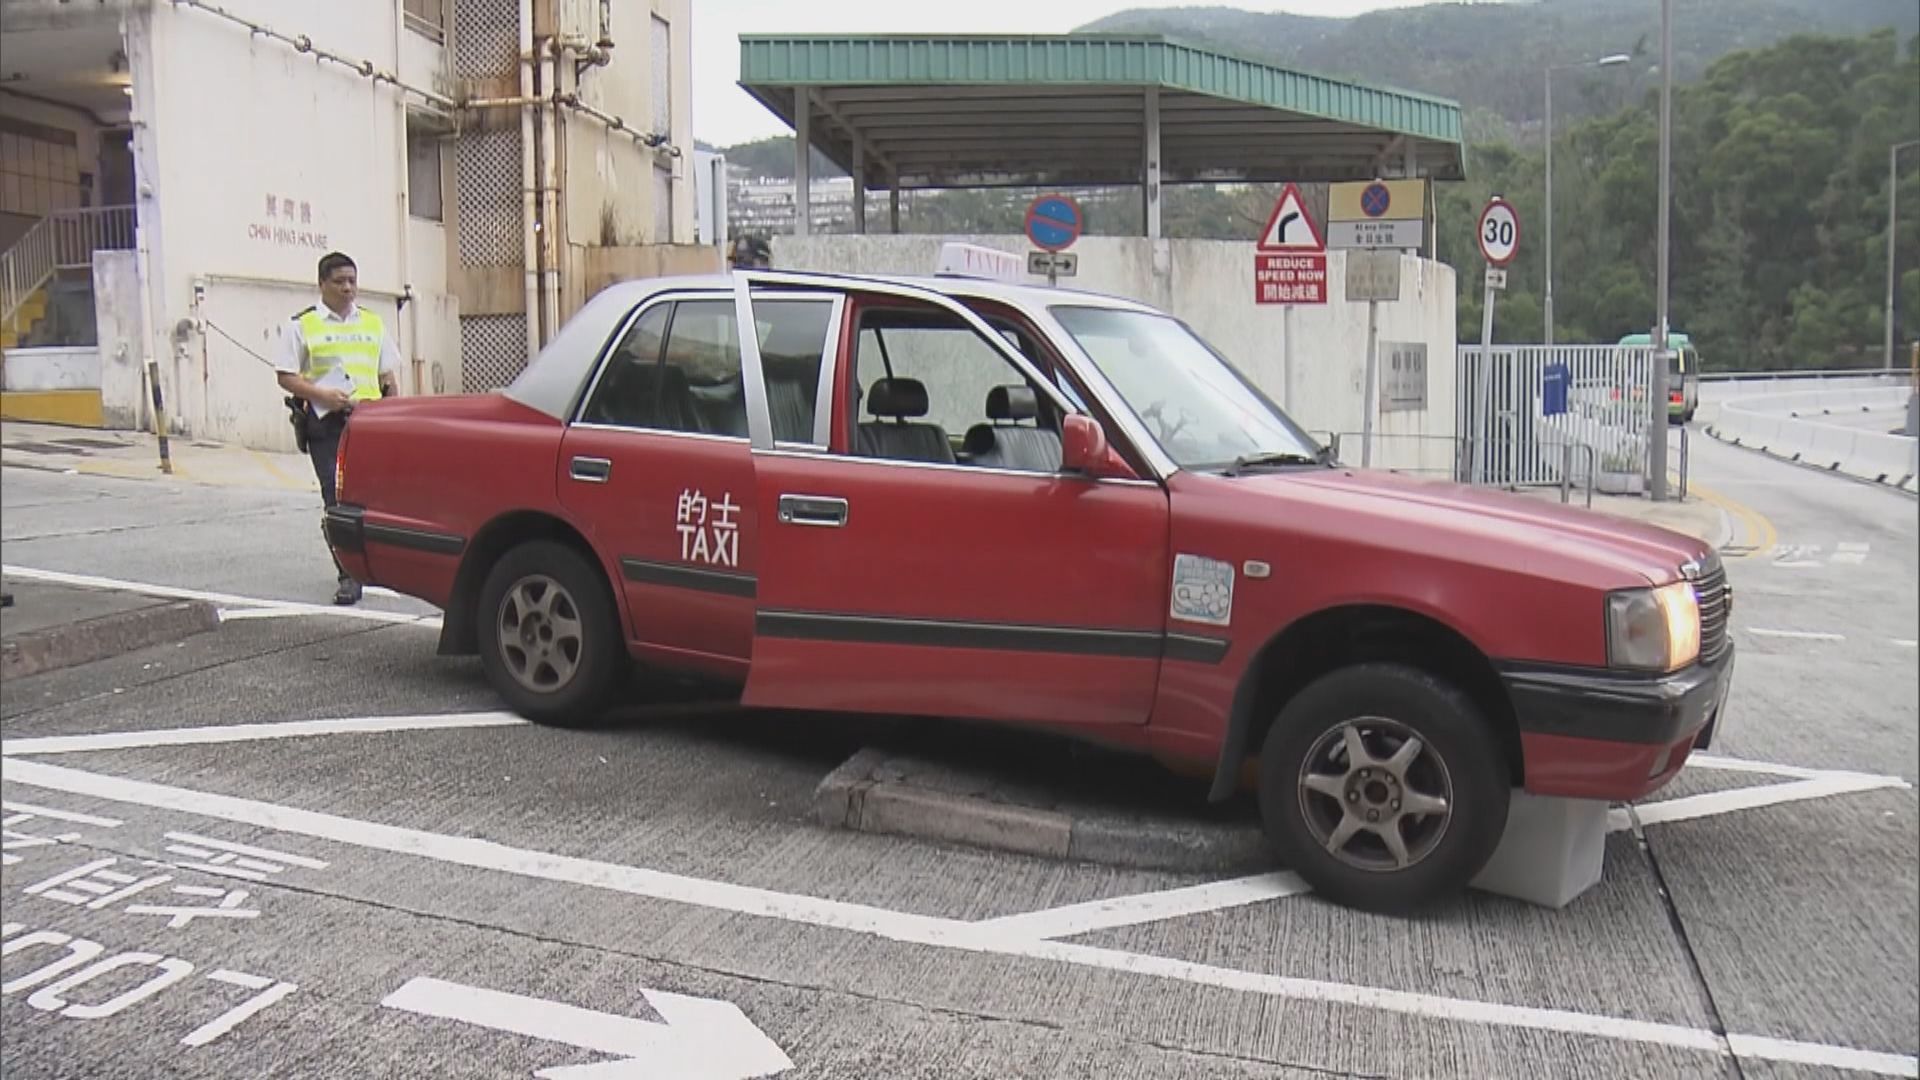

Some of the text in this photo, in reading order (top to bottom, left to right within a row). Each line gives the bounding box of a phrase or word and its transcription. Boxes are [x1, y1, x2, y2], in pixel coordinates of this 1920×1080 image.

[298, 231, 328, 249] HOUSE
[1485, 218, 1513, 246] 30
[1267, 258, 1315, 269] REDUCE
[1258, 270, 1325, 281] SPEED NOW
[677, 488, 741, 530] 的士
[676, 524, 739, 567] TAXI
